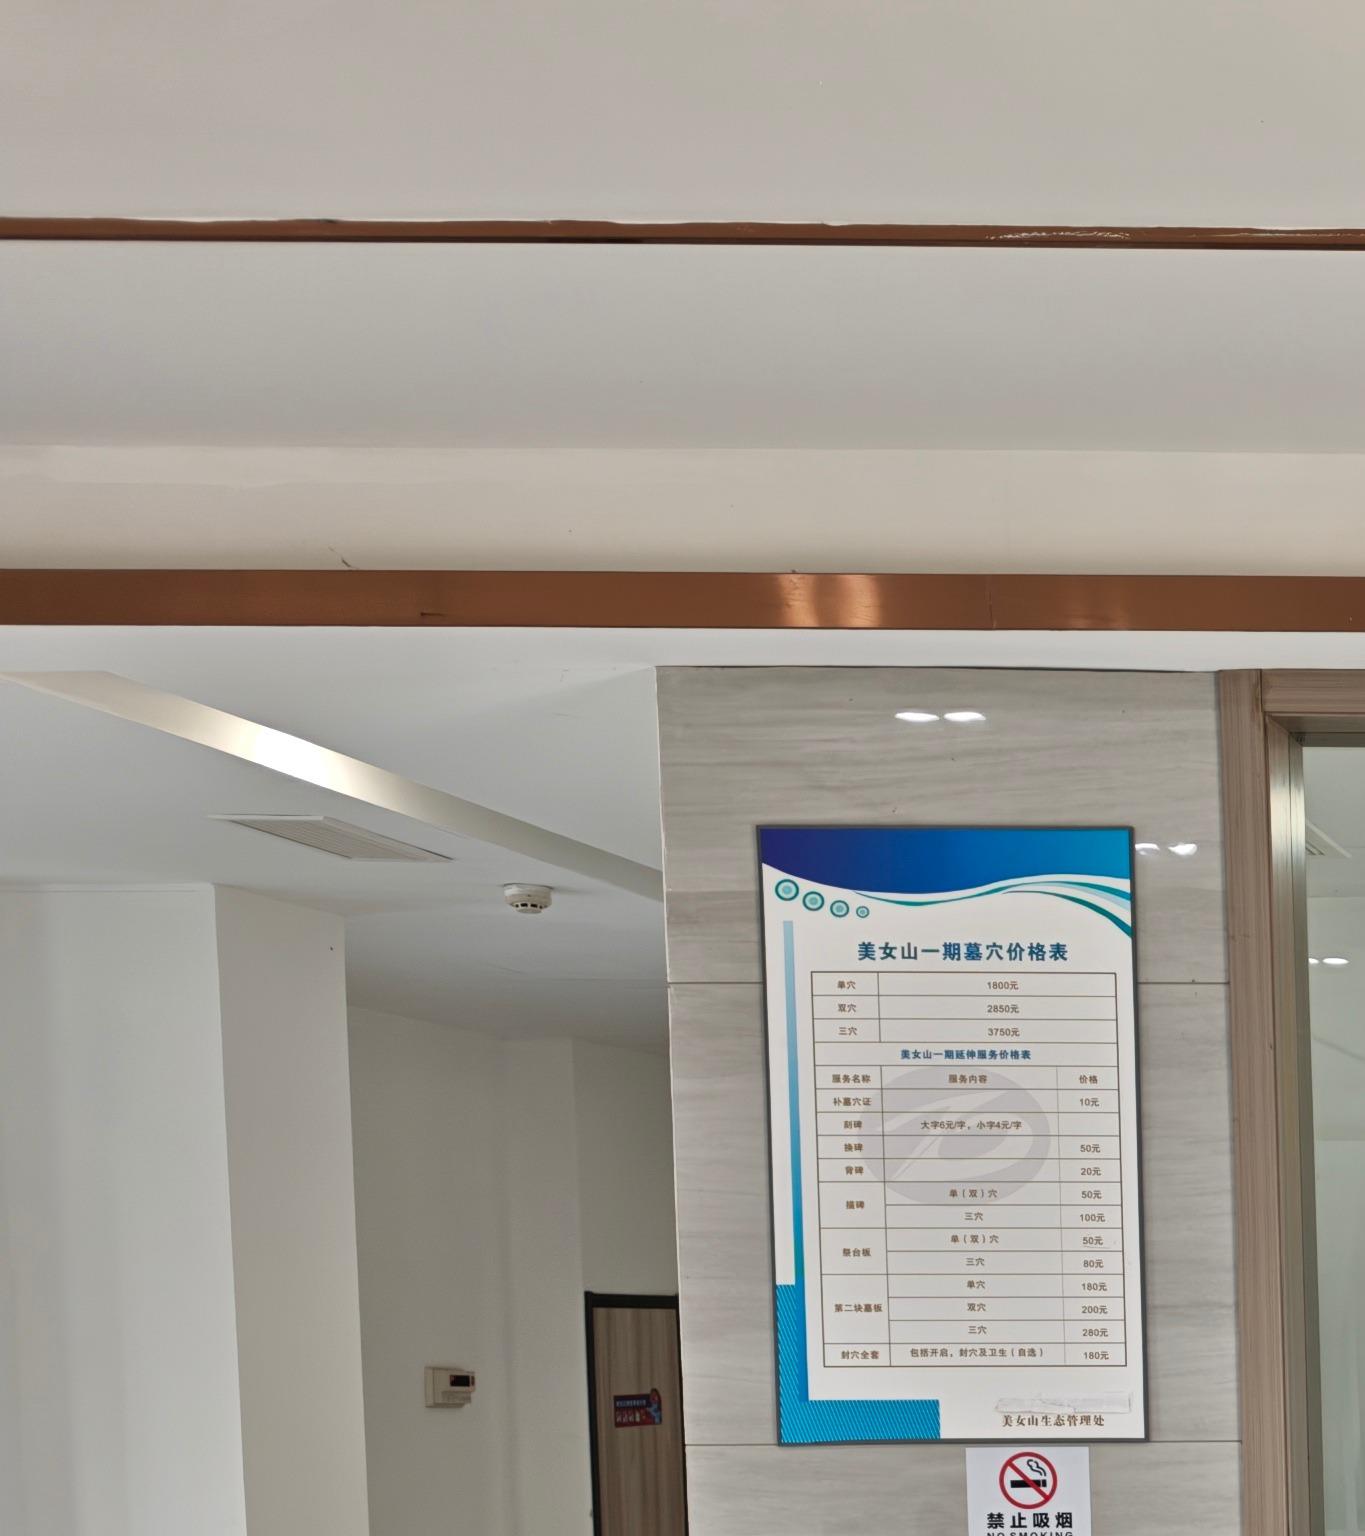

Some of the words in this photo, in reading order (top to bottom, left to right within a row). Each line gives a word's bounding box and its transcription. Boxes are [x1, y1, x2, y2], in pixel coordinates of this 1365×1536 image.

[857, 941, 1069, 961] 美女山一期墓穴价格表
[837, 980, 857, 991] 单穴
[987, 980, 1019, 991] 1800元
[837, 1003, 857, 1014] 双穴
[987, 1004, 1020, 1014] 2850元
[838, 1026, 858, 1036] 三穴
[987, 1027, 1020, 1037] 3750元
[900, 1049, 1032, 1060] 美女山一期延伸服务价格表
[831, 1074, 872, 1084] 服务名称
[948, 1074, 988, 1085] 服务内容
[1079, 1074, 1099, 1085] 价格
[1080, 1097, 1100, 1107] 10元
[1080, 1143, 1101, 1153] 50元
[1080, 1167, 1102, 1176] 20元
[1081, 1190, 1102, 1199] 50元
[964, 1212, 984, 1221] 三穴
[1079, 1213, 1106, 1223] 100元
[1083, 1236, 1103, 1245] 50元
[966, 1257, 985, 1267] 三穴
[1083, 1259, 1104, 1269] 80元
[966, 1280, 986, 1290] 单穴
[1081, 1281, 1107, 1292] 180元
[967, 1302, 986, 1312] 双穴
[1081, 1304, 1108, 1315] 200元
[968, 1325, 987, 1335] 三穴
[1082, 1327, 1109, 1338] 280元
[1083, 1350, 1110, 1360] 180元
[1002, 1414, 1105, 1427] 美女山生态管理处
[987, 1511, 1073, 1529] 禁止吸烟
